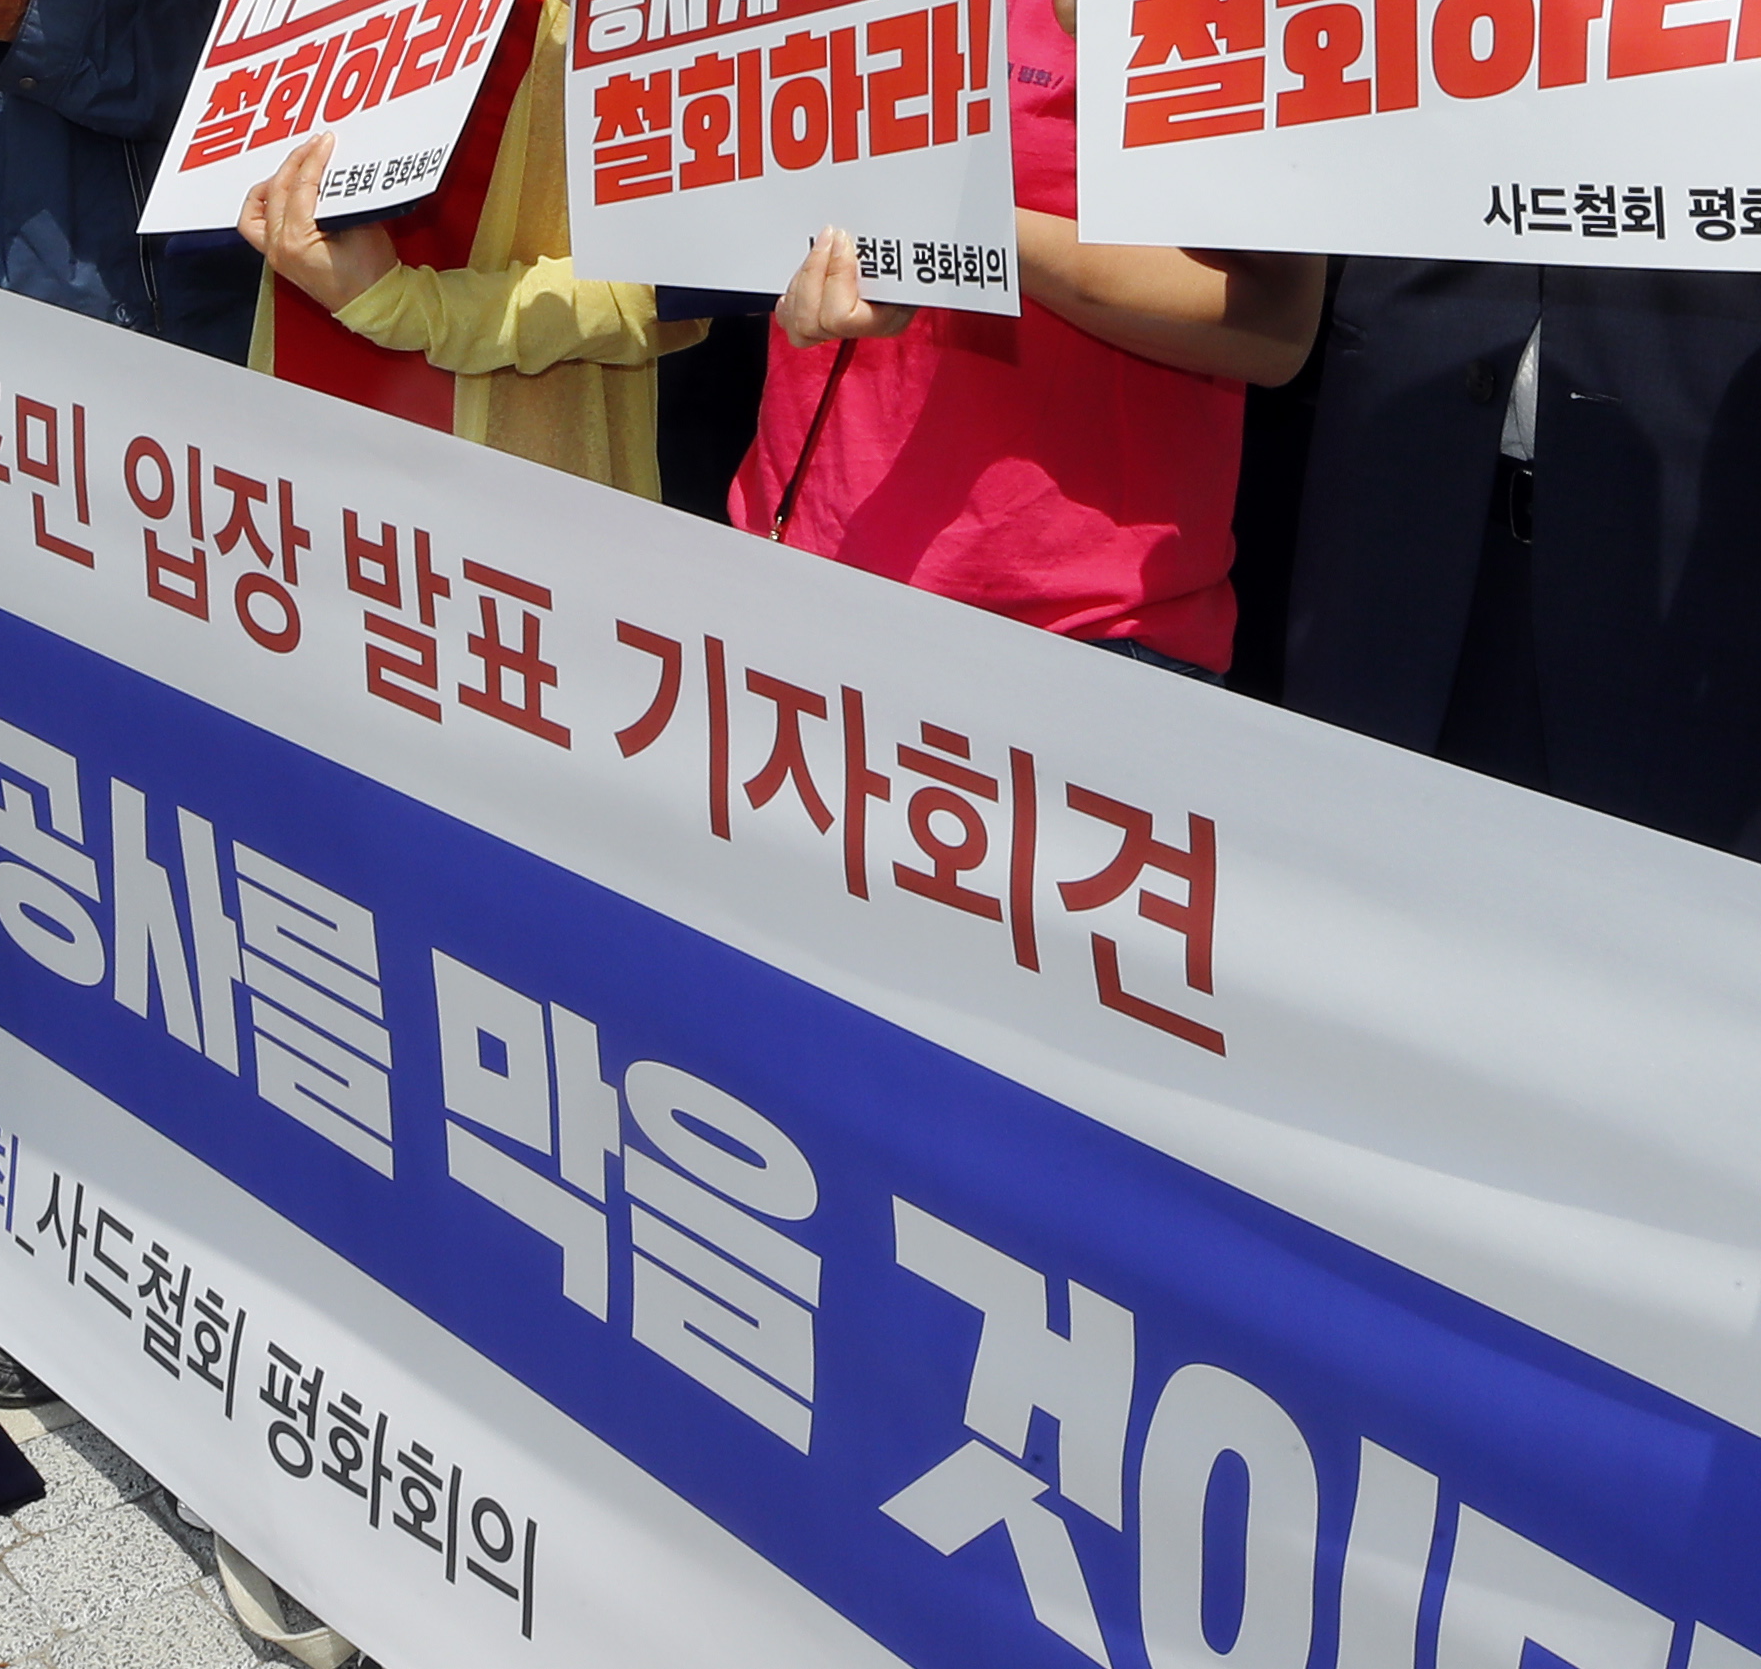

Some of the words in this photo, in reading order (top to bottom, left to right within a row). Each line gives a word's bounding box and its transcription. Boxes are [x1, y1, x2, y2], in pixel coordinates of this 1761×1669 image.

[382, 143, 449, 190] 평화회의
[1482, 185, 1665, 240] 사드철회
[913, 241, 1008, 292] 평화회의
[124, 434, 312, 655] 입장
[342, 508, 571, 751] 발표
[612, 618, 1228, 1058] 기자회견
[431, 947, 822, 1456] 막을
[260, 1341, 537, 1640] 평화회의
